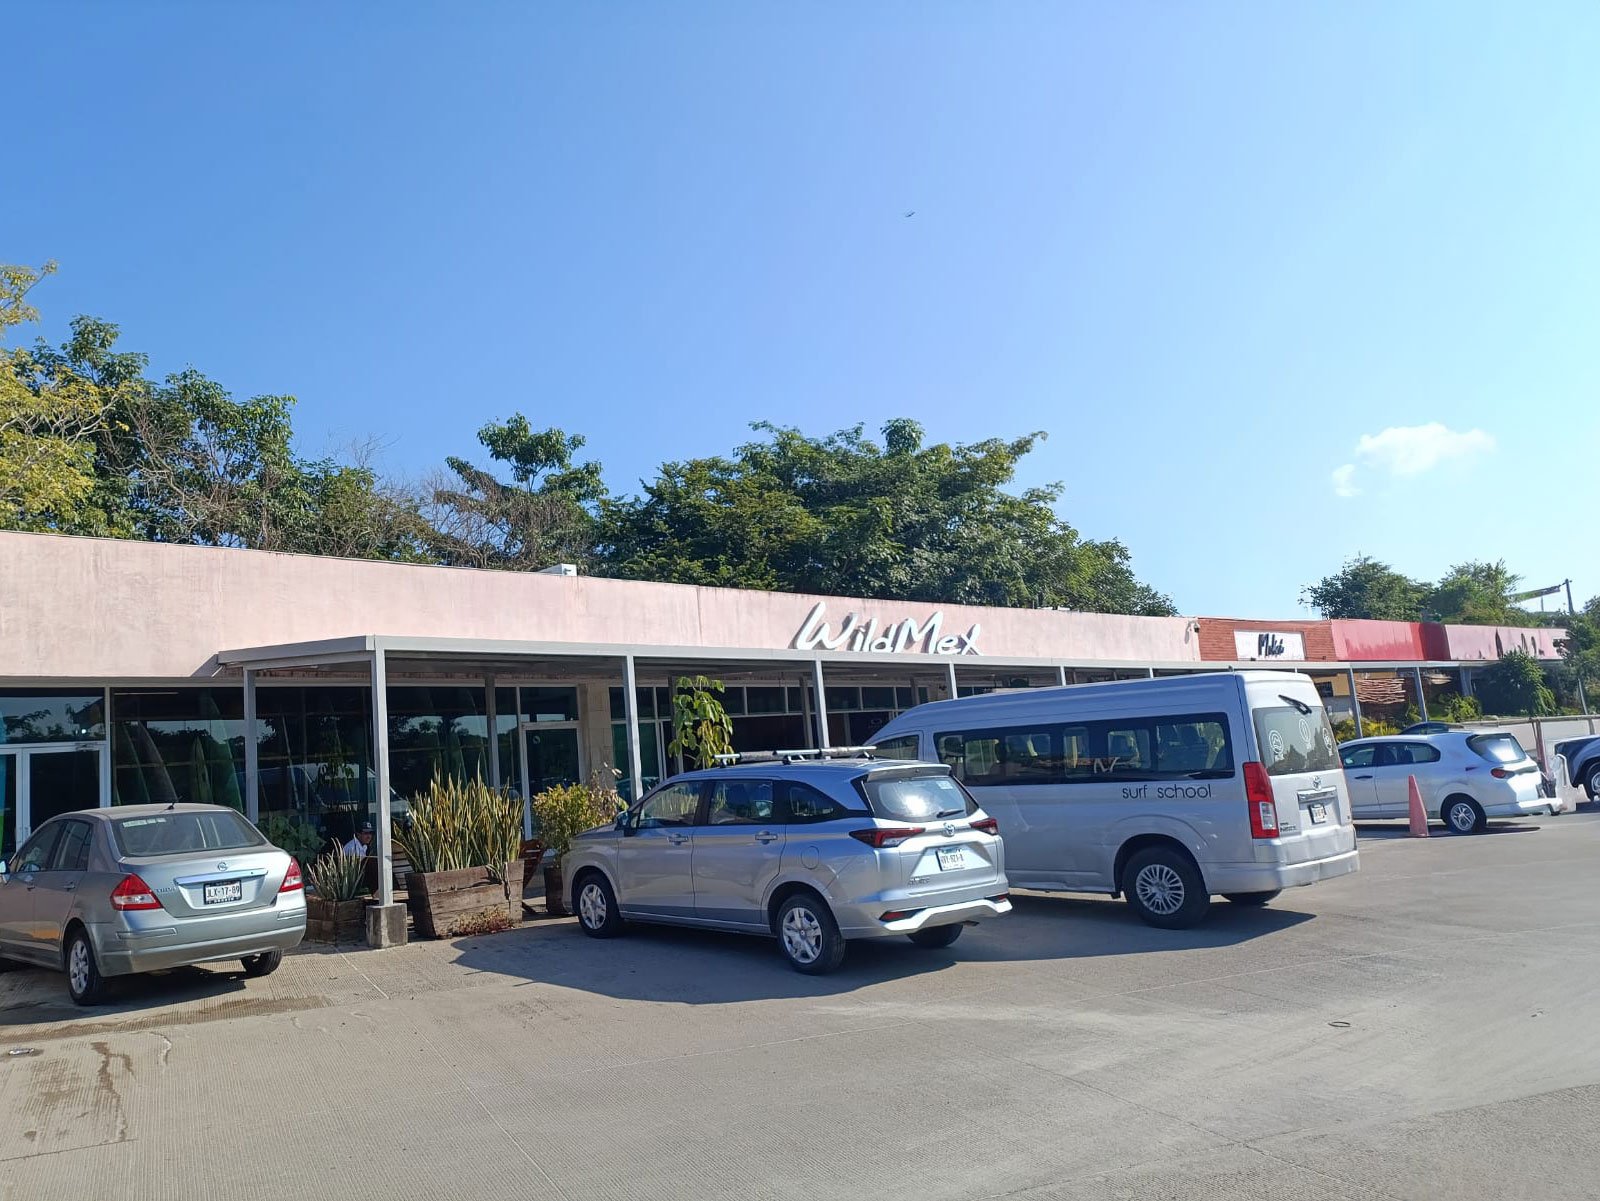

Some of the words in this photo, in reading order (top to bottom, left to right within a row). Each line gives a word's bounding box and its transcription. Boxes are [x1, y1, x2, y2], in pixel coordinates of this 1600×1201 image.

[797, 600, 983, 656] WildMex
[1122, 784, 1147, 799] surf
[1157, 783, 1212, 799] school
